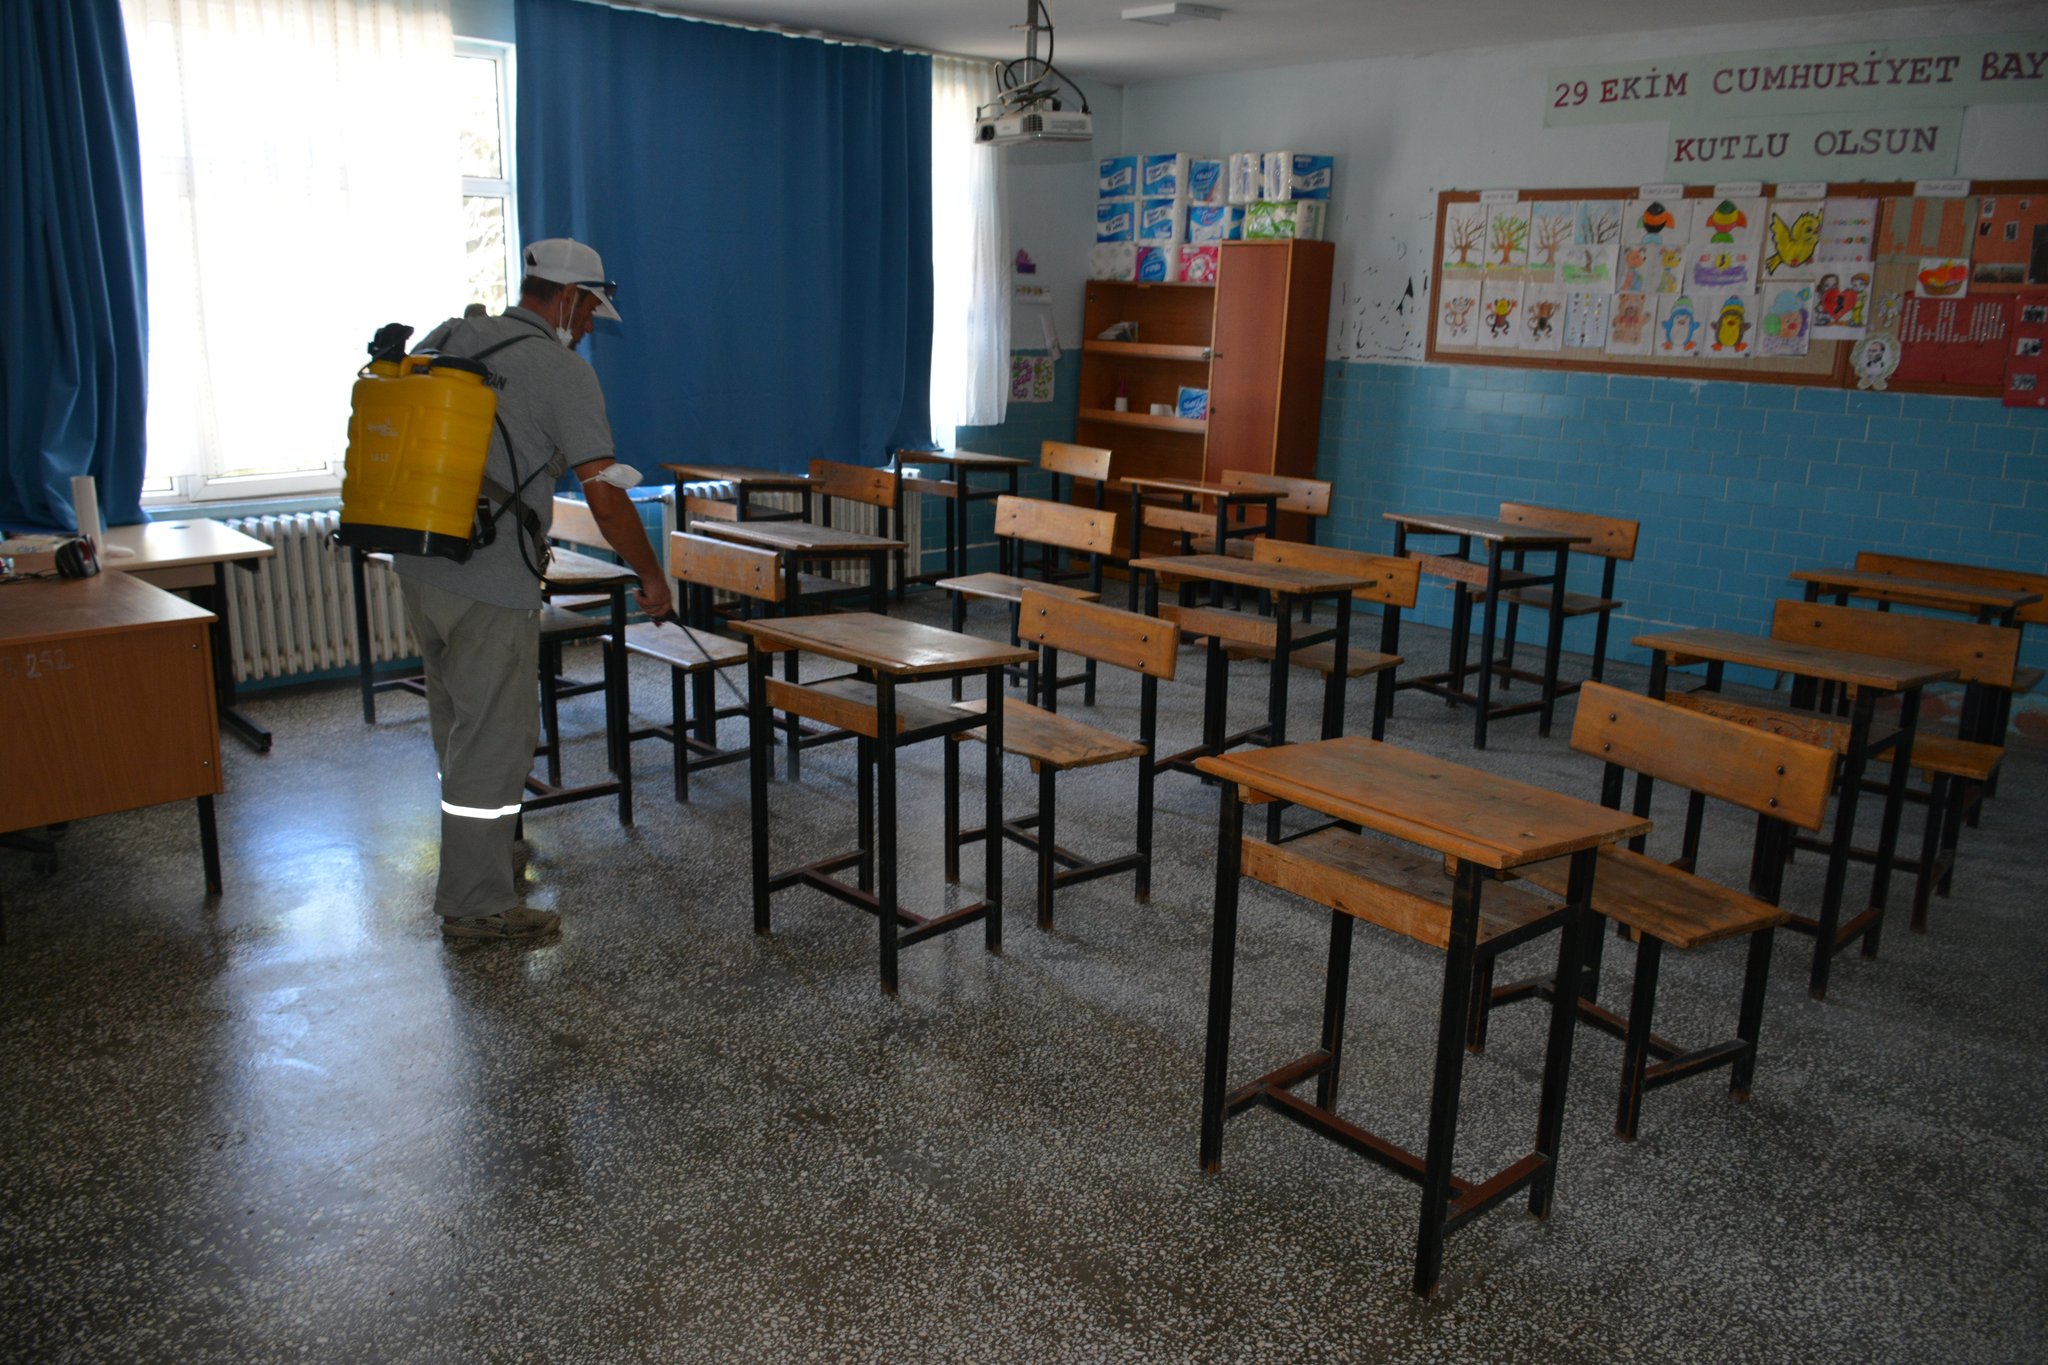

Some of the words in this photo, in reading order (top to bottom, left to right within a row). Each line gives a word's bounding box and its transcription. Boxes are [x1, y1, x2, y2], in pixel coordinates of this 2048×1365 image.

[1554, 80, 1589, 108] 29
[1599, 67, 1689, 103] EKİM
[1713, 50, 1960, 94] CUMHURİYET
[1980, 51, 2048, 82] BAY
[1673, 133, 1790, 162] KUTLU
[1814, 126, 1939, 156] OLSUN
